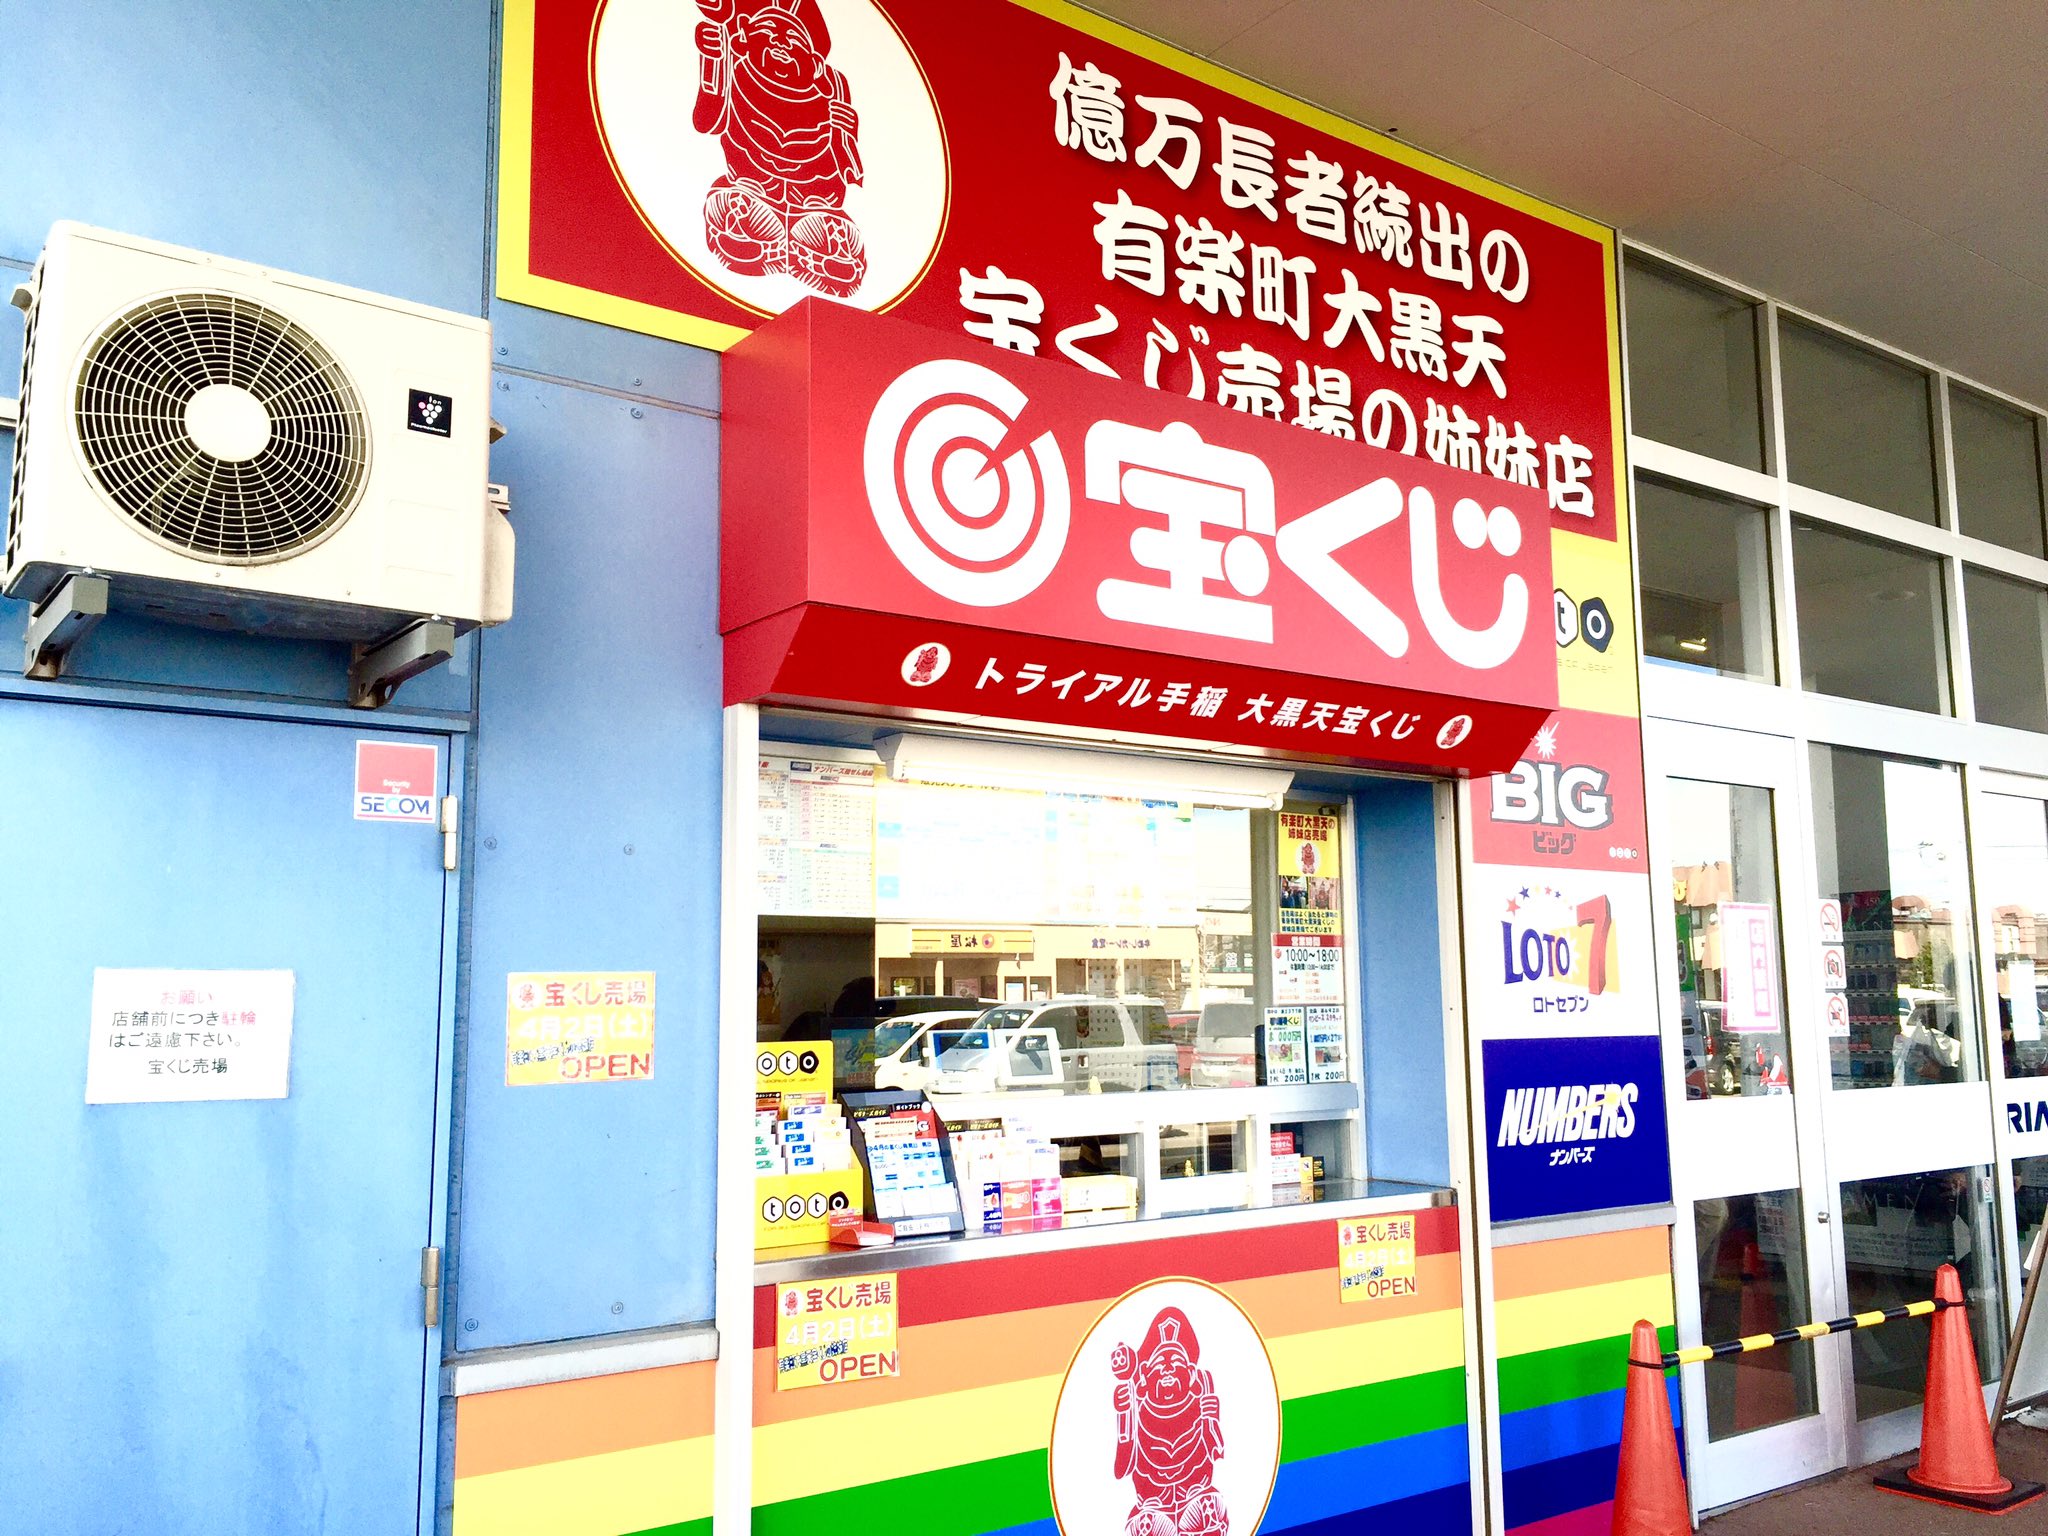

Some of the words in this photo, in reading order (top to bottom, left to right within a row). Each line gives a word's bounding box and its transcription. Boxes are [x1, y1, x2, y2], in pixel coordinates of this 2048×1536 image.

[1049, 52, 1529, 303] 億万長者続出の
[1093, 189, 1507, 398] 有楽町大黒天
[959, 266, 1595, 518] 宝くじ売場の姉妹店
[1084, 419, 1529, 669] 宝くじ
[975, 657, 1229, 719] トライアル手稲
[1237, 693, 1421, 741] 大黒天宝くじ
[361, 796, 430, 815] SECOM
[1490, 757, 1614, 831] BIG
[1532, 830, 1577, 856] ビッグ
[1501, 920, 1570, 984] LOTO
[1576, 894, 1612, 995] 7
[161, 990, 214, 1005] お願い
[1533, 995, 1589, 1013] ロトセブン
[112, 1011, 256, 1027] 店舗前につき駐輪
[109, 1032, 241, 1048] はご遠慮下さい。
[148, 1058, 228, 1074] 宝くじ売場
[562, 1053, 650, 1079] OPEN
[1497, 1082, 1639, 1147] NUMBERS
[1549, 1146, 1596, 1167] ナンバーズ
[766, 1194, 847, 1219] toto
[806, 1281, 891, 1312] 宝くじ売場
[1367, 1276, 1416, 1297] OPEN
[785, 1312, 893, 1346] 4月2日(土)
[820, 1351, 896, 1382] OPEN
